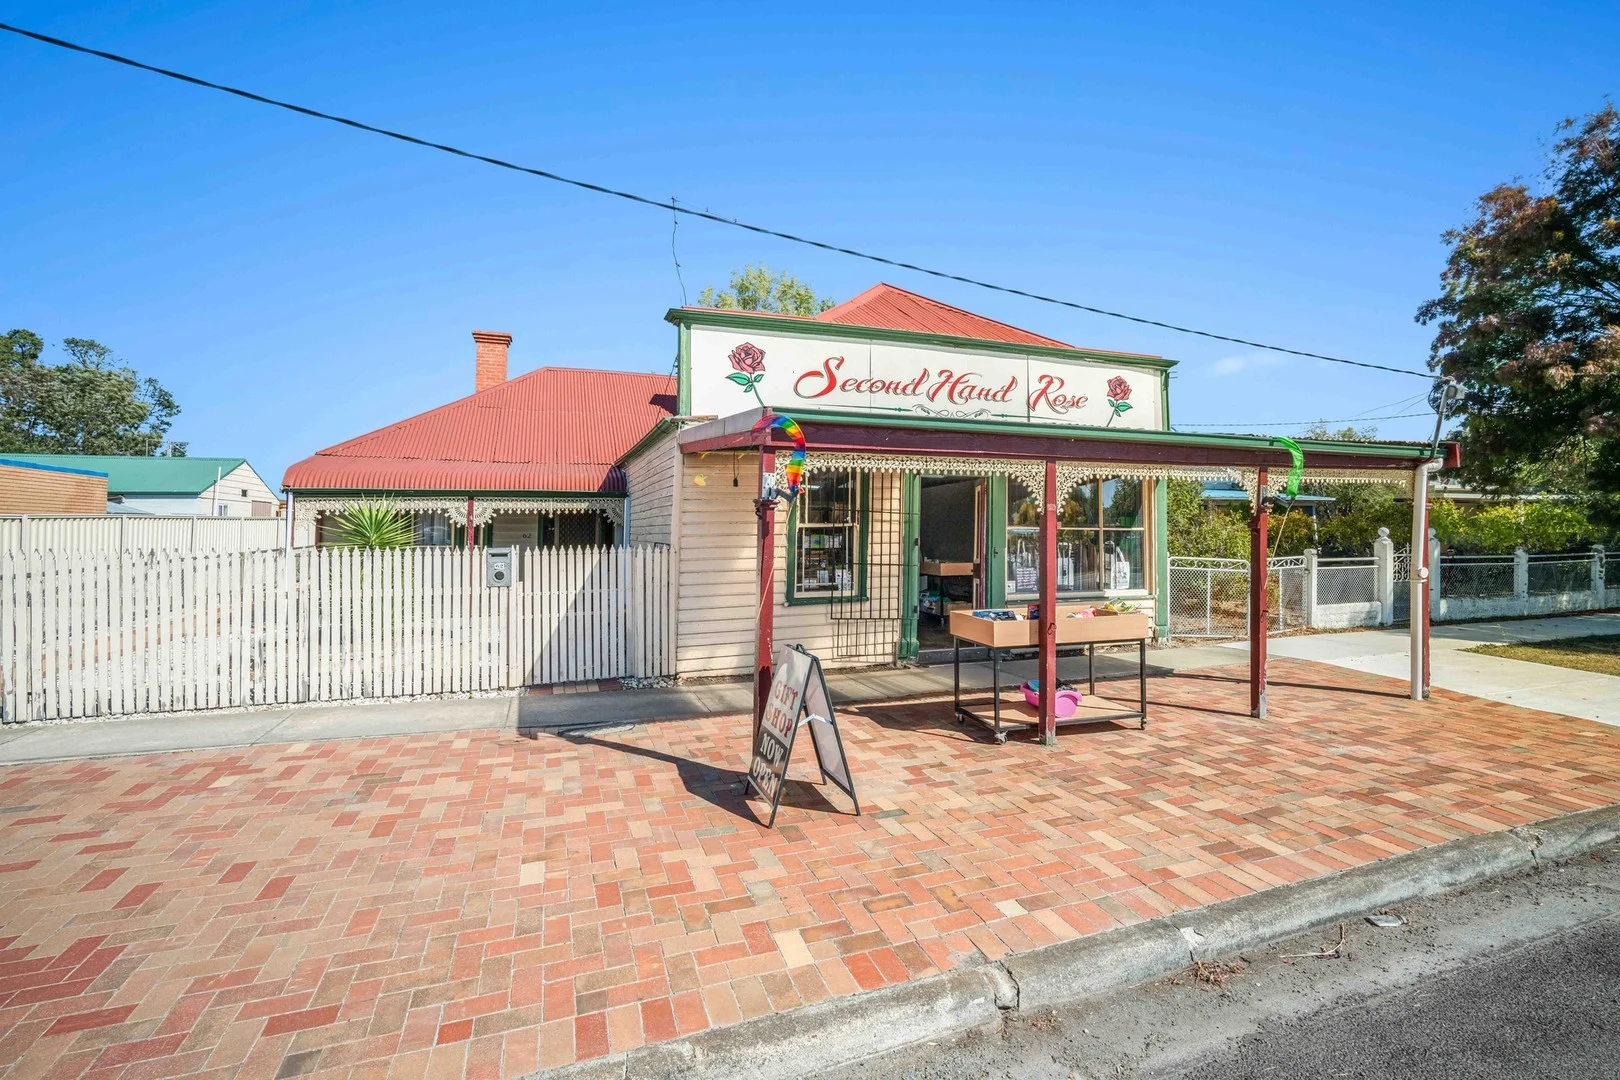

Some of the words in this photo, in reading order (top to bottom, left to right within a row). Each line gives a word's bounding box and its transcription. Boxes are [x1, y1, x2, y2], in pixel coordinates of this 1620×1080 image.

[794, 356, 929, 399] Second
[926, 369, 1018, 405] Hand
[1028, 374, 1088, 414] Rose
[774, 680, 798, 710] GIFT
[766, 703, 793, 738] SHOP
[760, 733, 784, 767] NOW
[753, 757, 778, 798] OPEN
